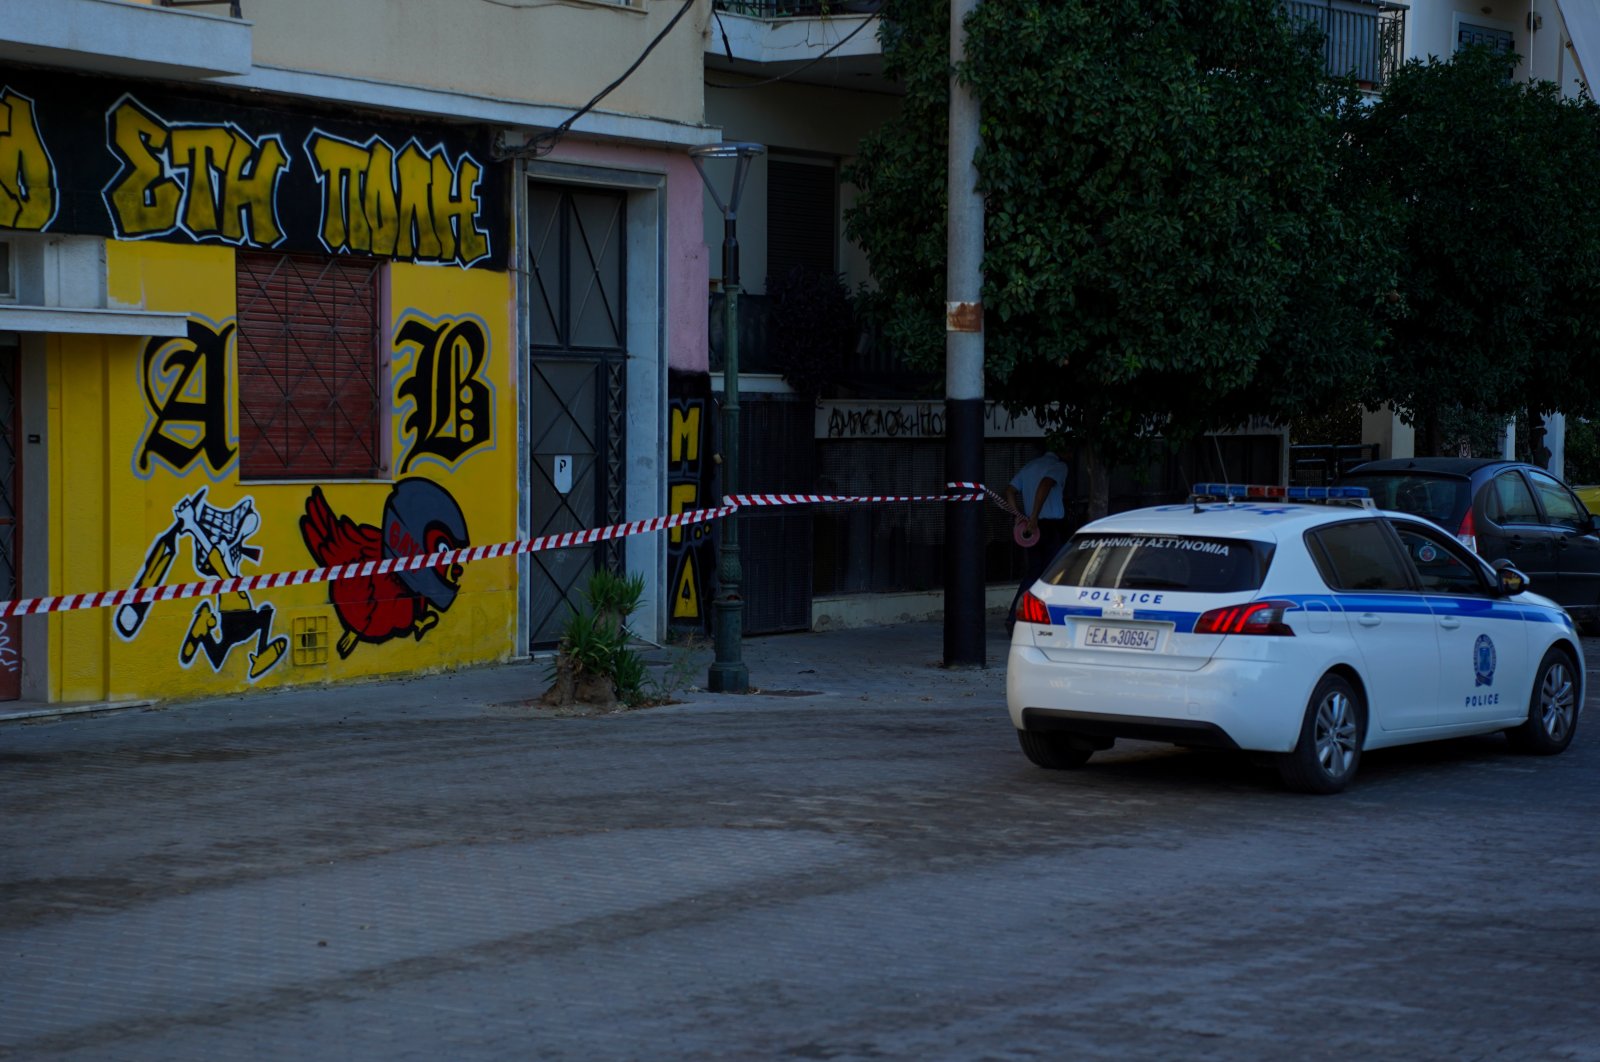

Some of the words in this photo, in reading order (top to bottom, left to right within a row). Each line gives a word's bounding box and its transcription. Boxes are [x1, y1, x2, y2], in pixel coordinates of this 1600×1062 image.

[1078, 537, 1145, 551] ΕΛΛΗΝΙΚΗ
[1145, 538, 1229, 557] ΑΣΤΥΝΟΜΙΑ
[1078, 590, 1164, 605] POLICE
[1117, 629, 1150, 648] 30694
[1465, 693, 1500, 707] POLICE
